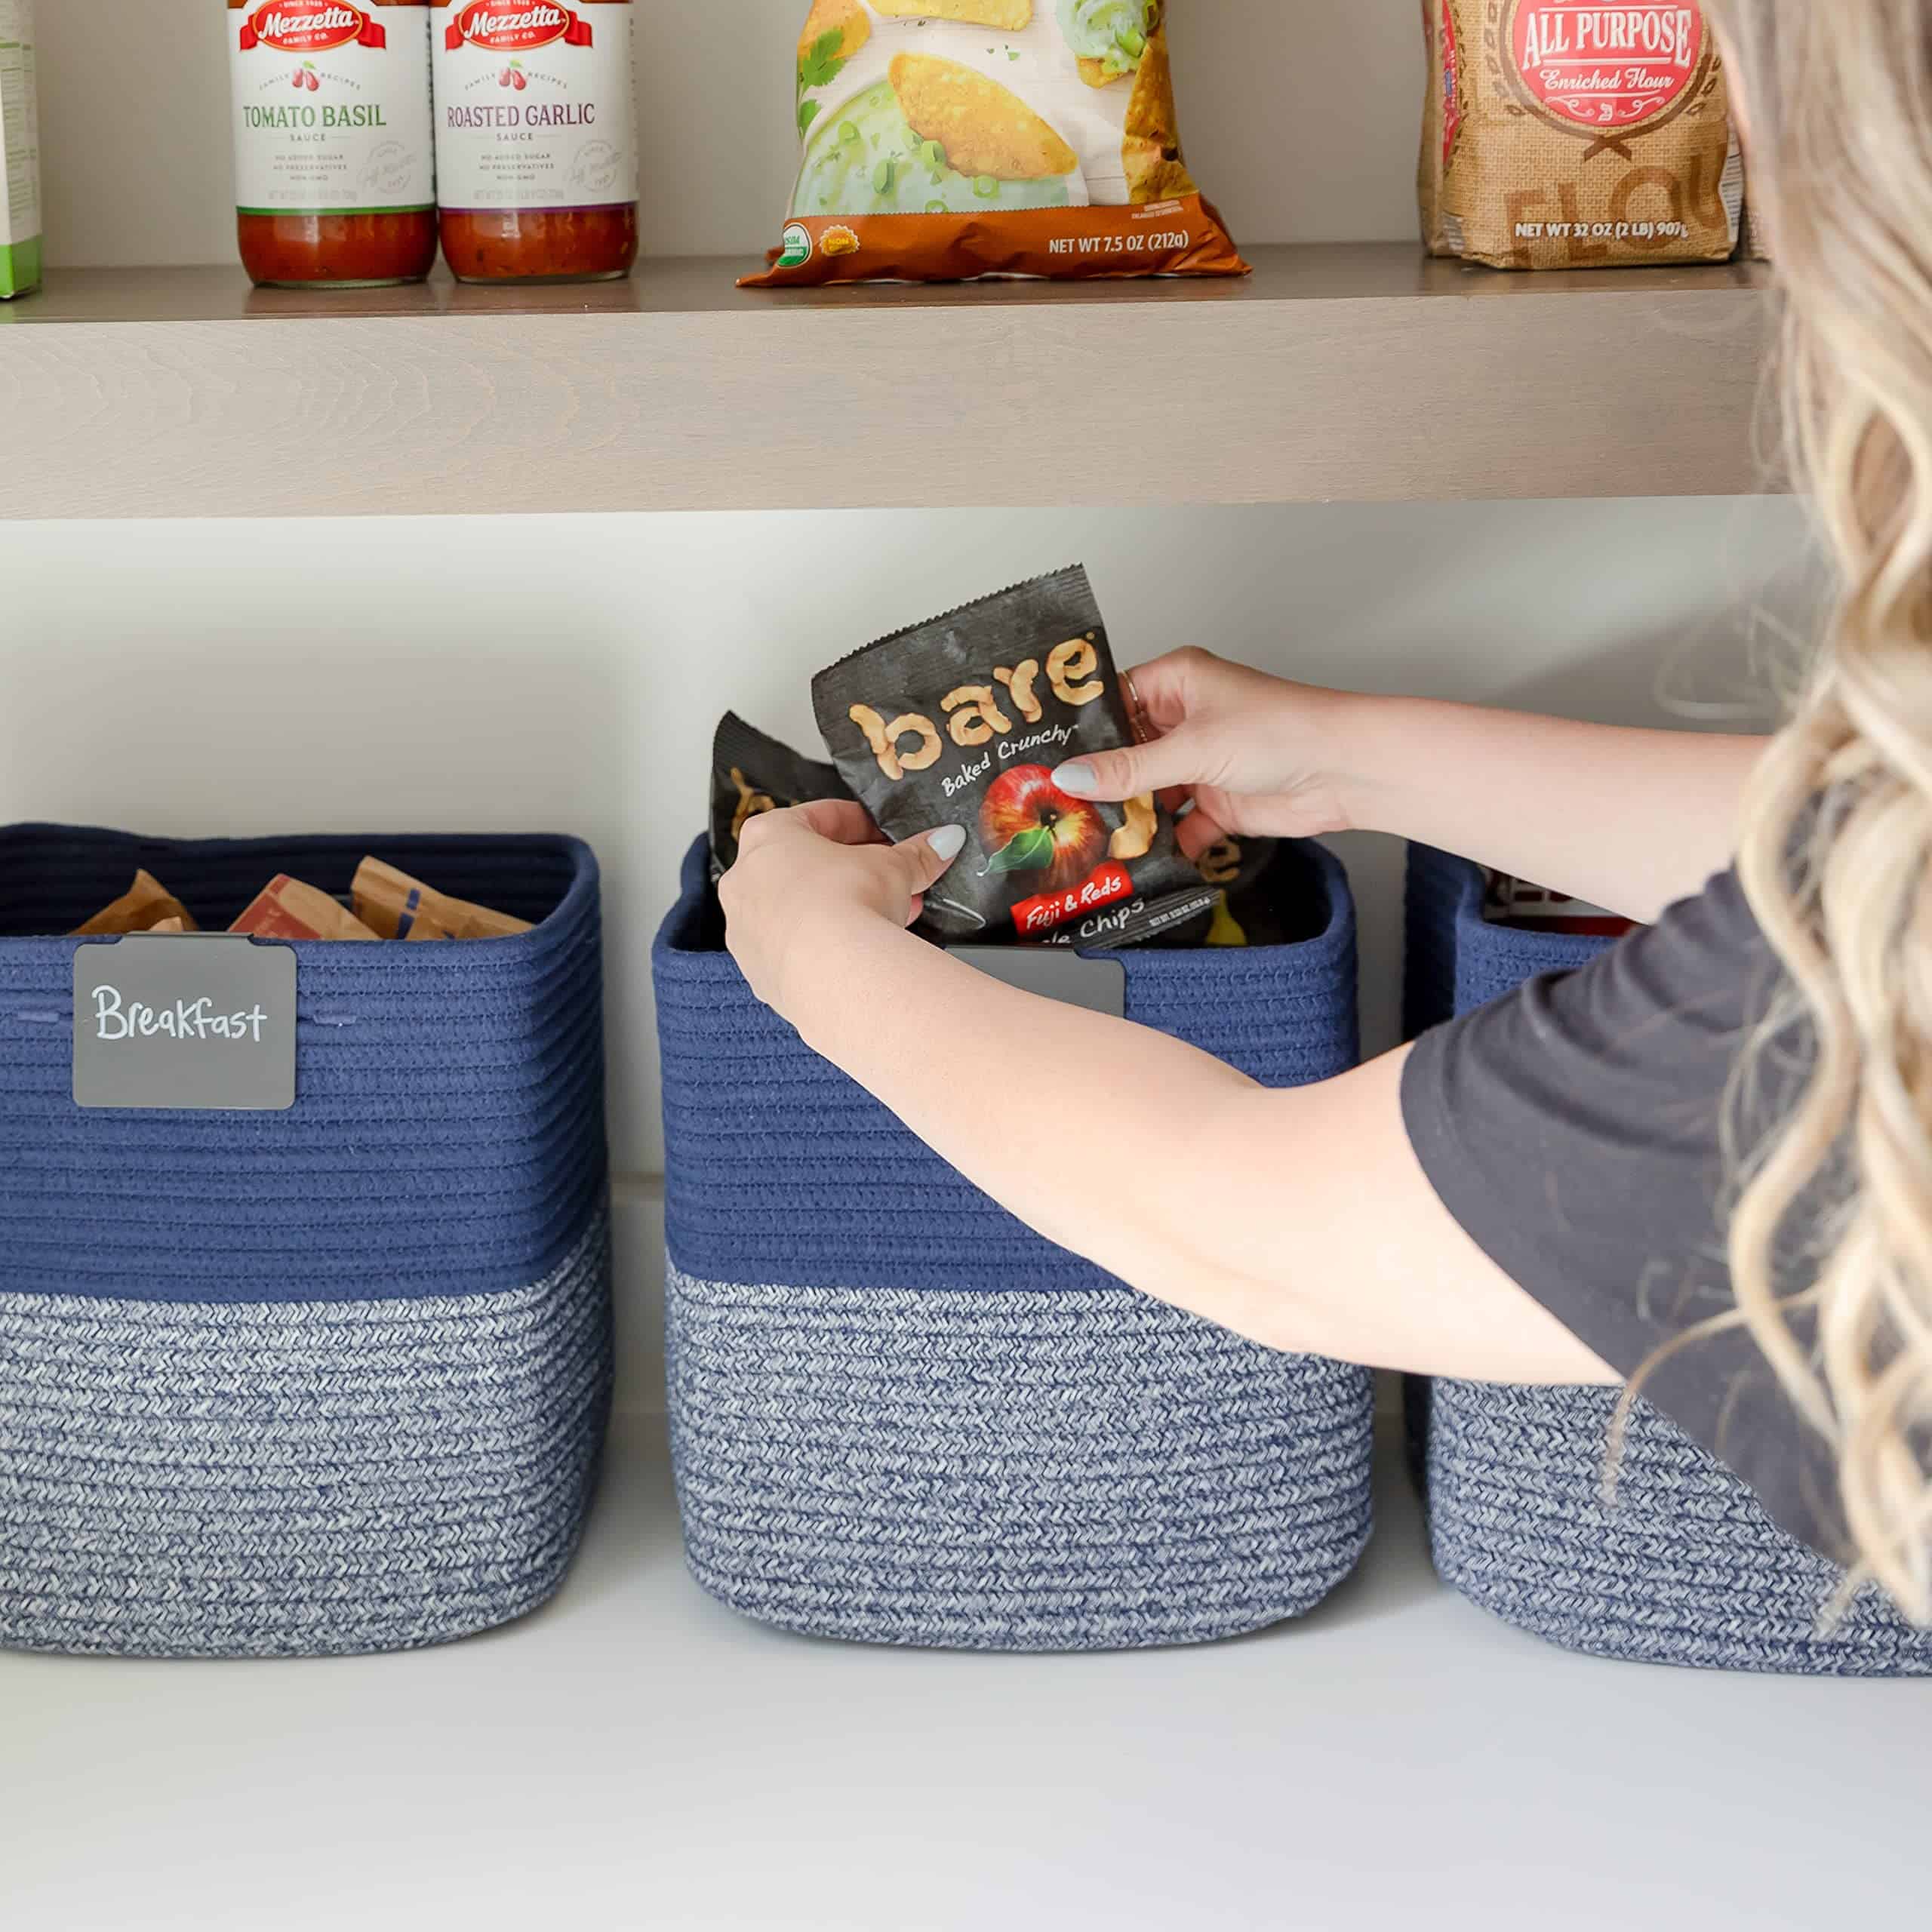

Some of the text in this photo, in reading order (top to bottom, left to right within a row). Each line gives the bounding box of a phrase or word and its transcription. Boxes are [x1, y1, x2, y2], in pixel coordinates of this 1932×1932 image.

[258, 7, 352, 38] Mezzetta
[464, 5, 560, 38] Mezzetta
[282, 35, 312, 45] FAMILY
[490, 34, 519, 44] FAMILY
[1522, 10, 1692, 70] ALL PURPOSE
[1540, 67, 1675, 91] Enriched Flour
[243, 103, 386, 128] TOMATO BASIL
[448, 103, 595, 128] ROASTED GARLIC
[290, 134, 325, 142] SAUCE
[497, 133, 534, 141] SAUCE
[1515, 223, 1543, 237] NET
[1546, 223, 1571, 237] WT
[1574, 223, 1589, 237] 32
[1592, 223, 1613, 237] OZ
[1616, 222, 1629, 239] (2
[1632, 222, 1654, 239] LB)
[1049, 238, 1075, 254] NET
[1078, 237, 1100, 252] WT
[1103, 236, 1124, 252] 7.5
[1126, 235, 1144, 251] OZ
[849, 638, 1105, 780] bare
[942, 724, 1072, 797] Baked Crunchy
[1026, 875, 1122, 929] Fuji & Reds
[1080, 898, 1146, 938] Chips
[91, 984, 268, 1041] Breakfast
